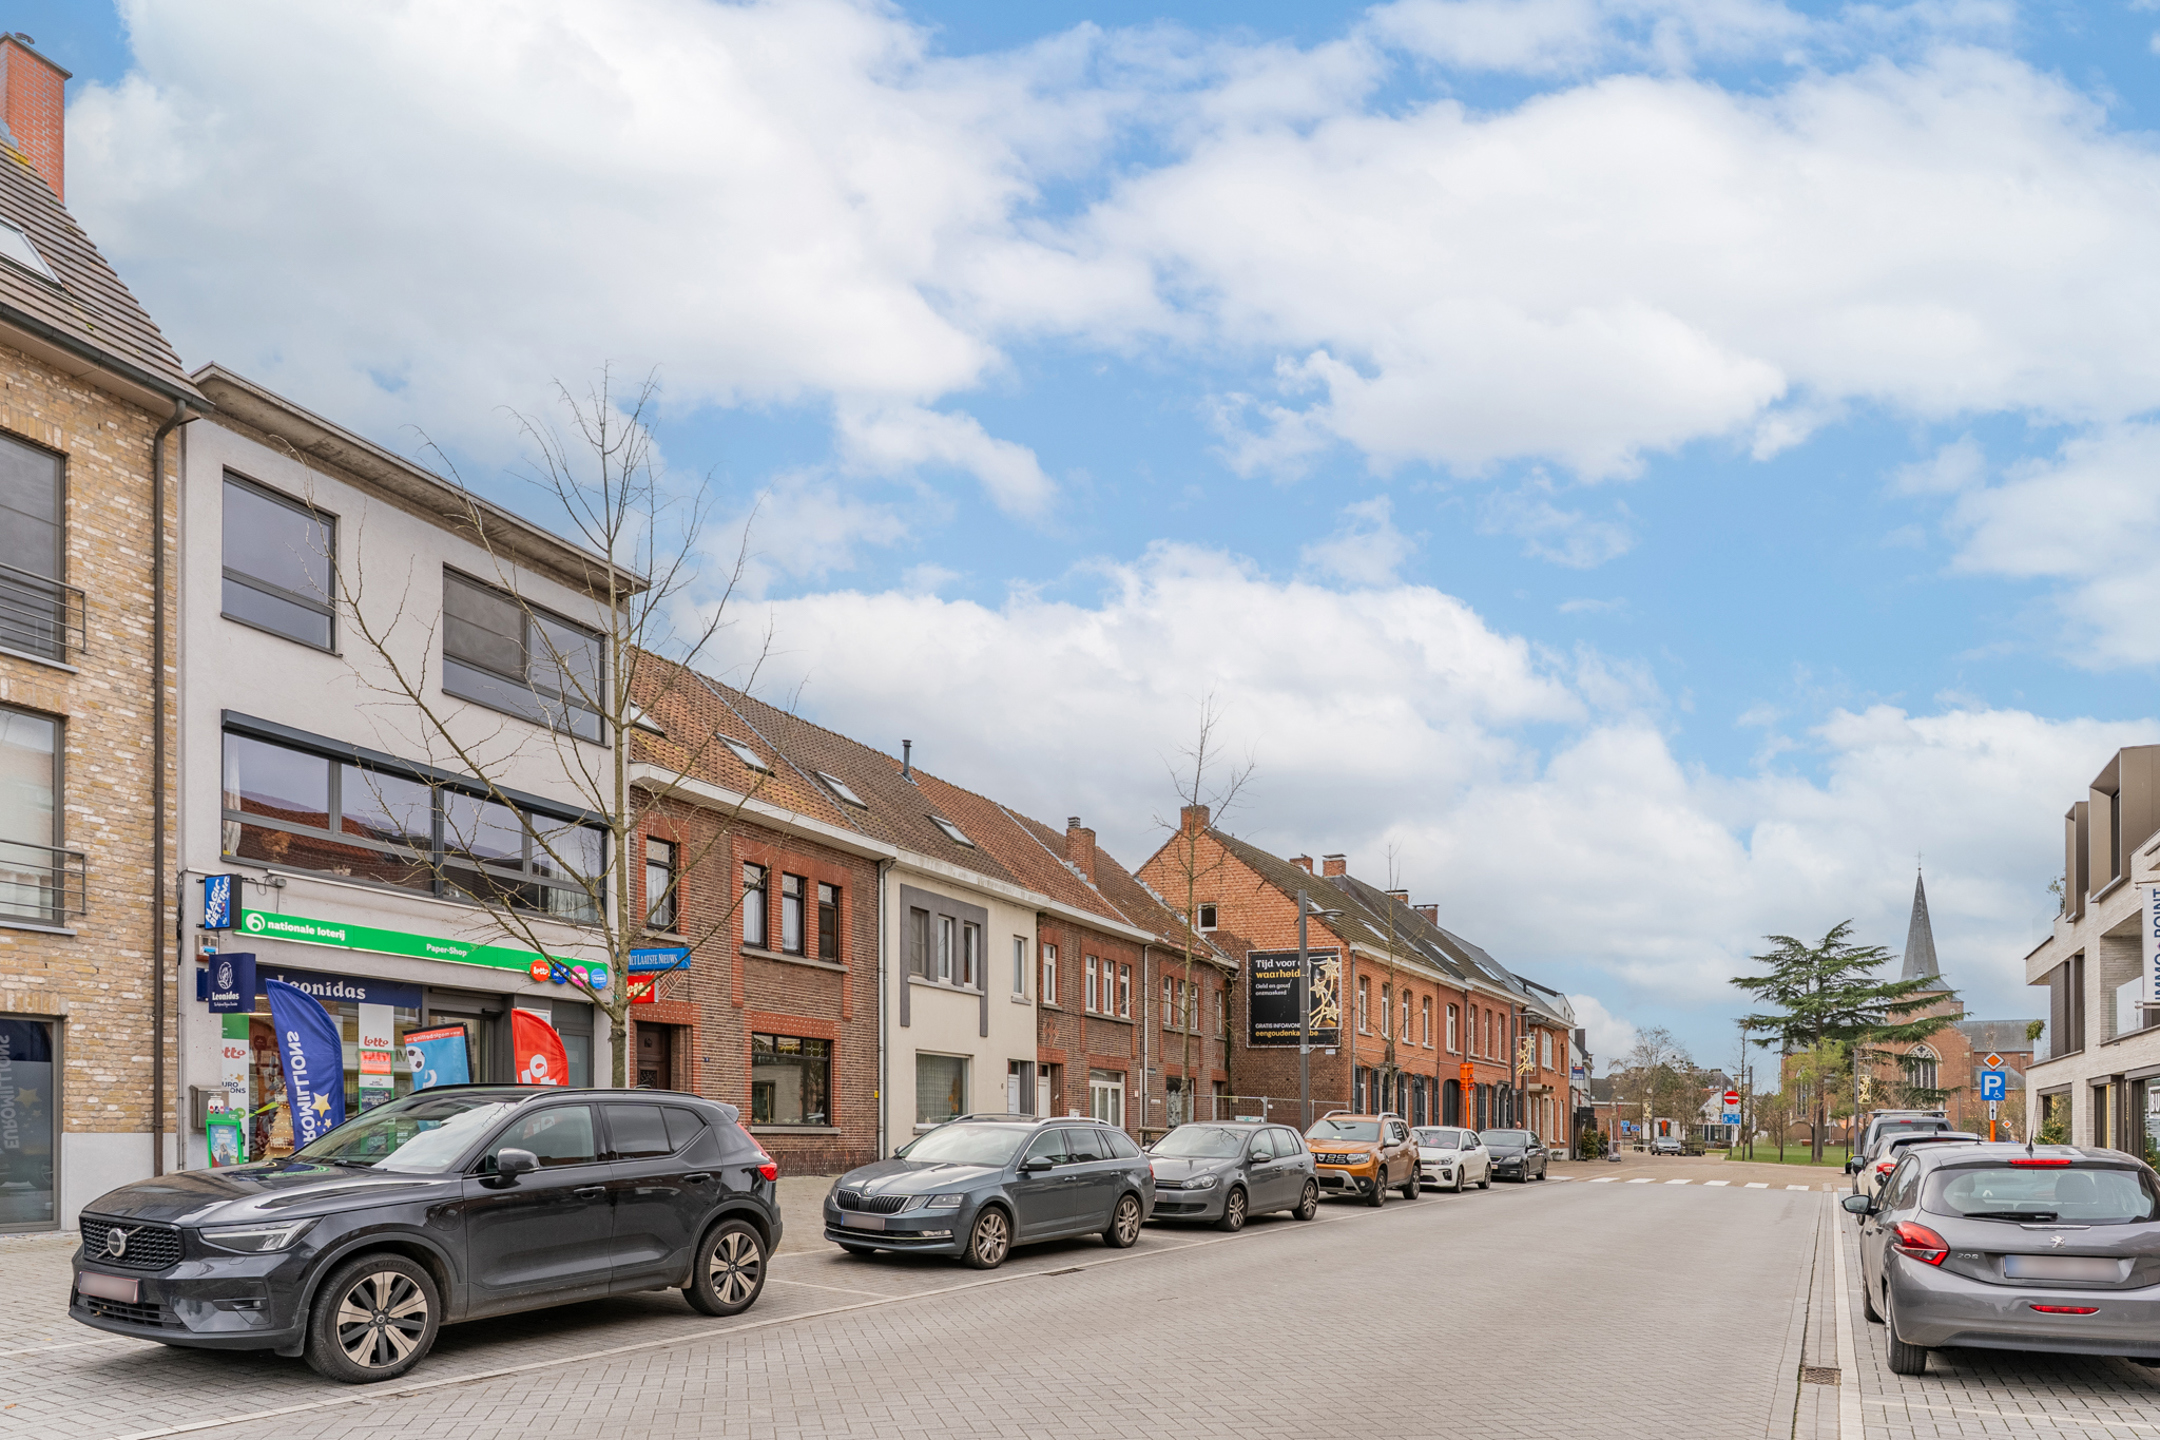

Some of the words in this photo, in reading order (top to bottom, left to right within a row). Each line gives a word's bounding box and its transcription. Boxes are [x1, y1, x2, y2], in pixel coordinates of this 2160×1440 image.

[205, 879, 220, 922] MAGIC
[267, 921, 315, 935] nationale
[316, 926, 346, 941] loterij
[426, 943, 468, 957] Paper-Shop
[1255, 959, 1274, 970] Tijd
[1255, 968, 1300, 979] waarheid
[212, 991, 239, 1001] Leonidas
[626, 981, 652, 997] otto
[1984, 1075, 2002, 1096] P
[1957, 1252, 1979, 1260] 208
